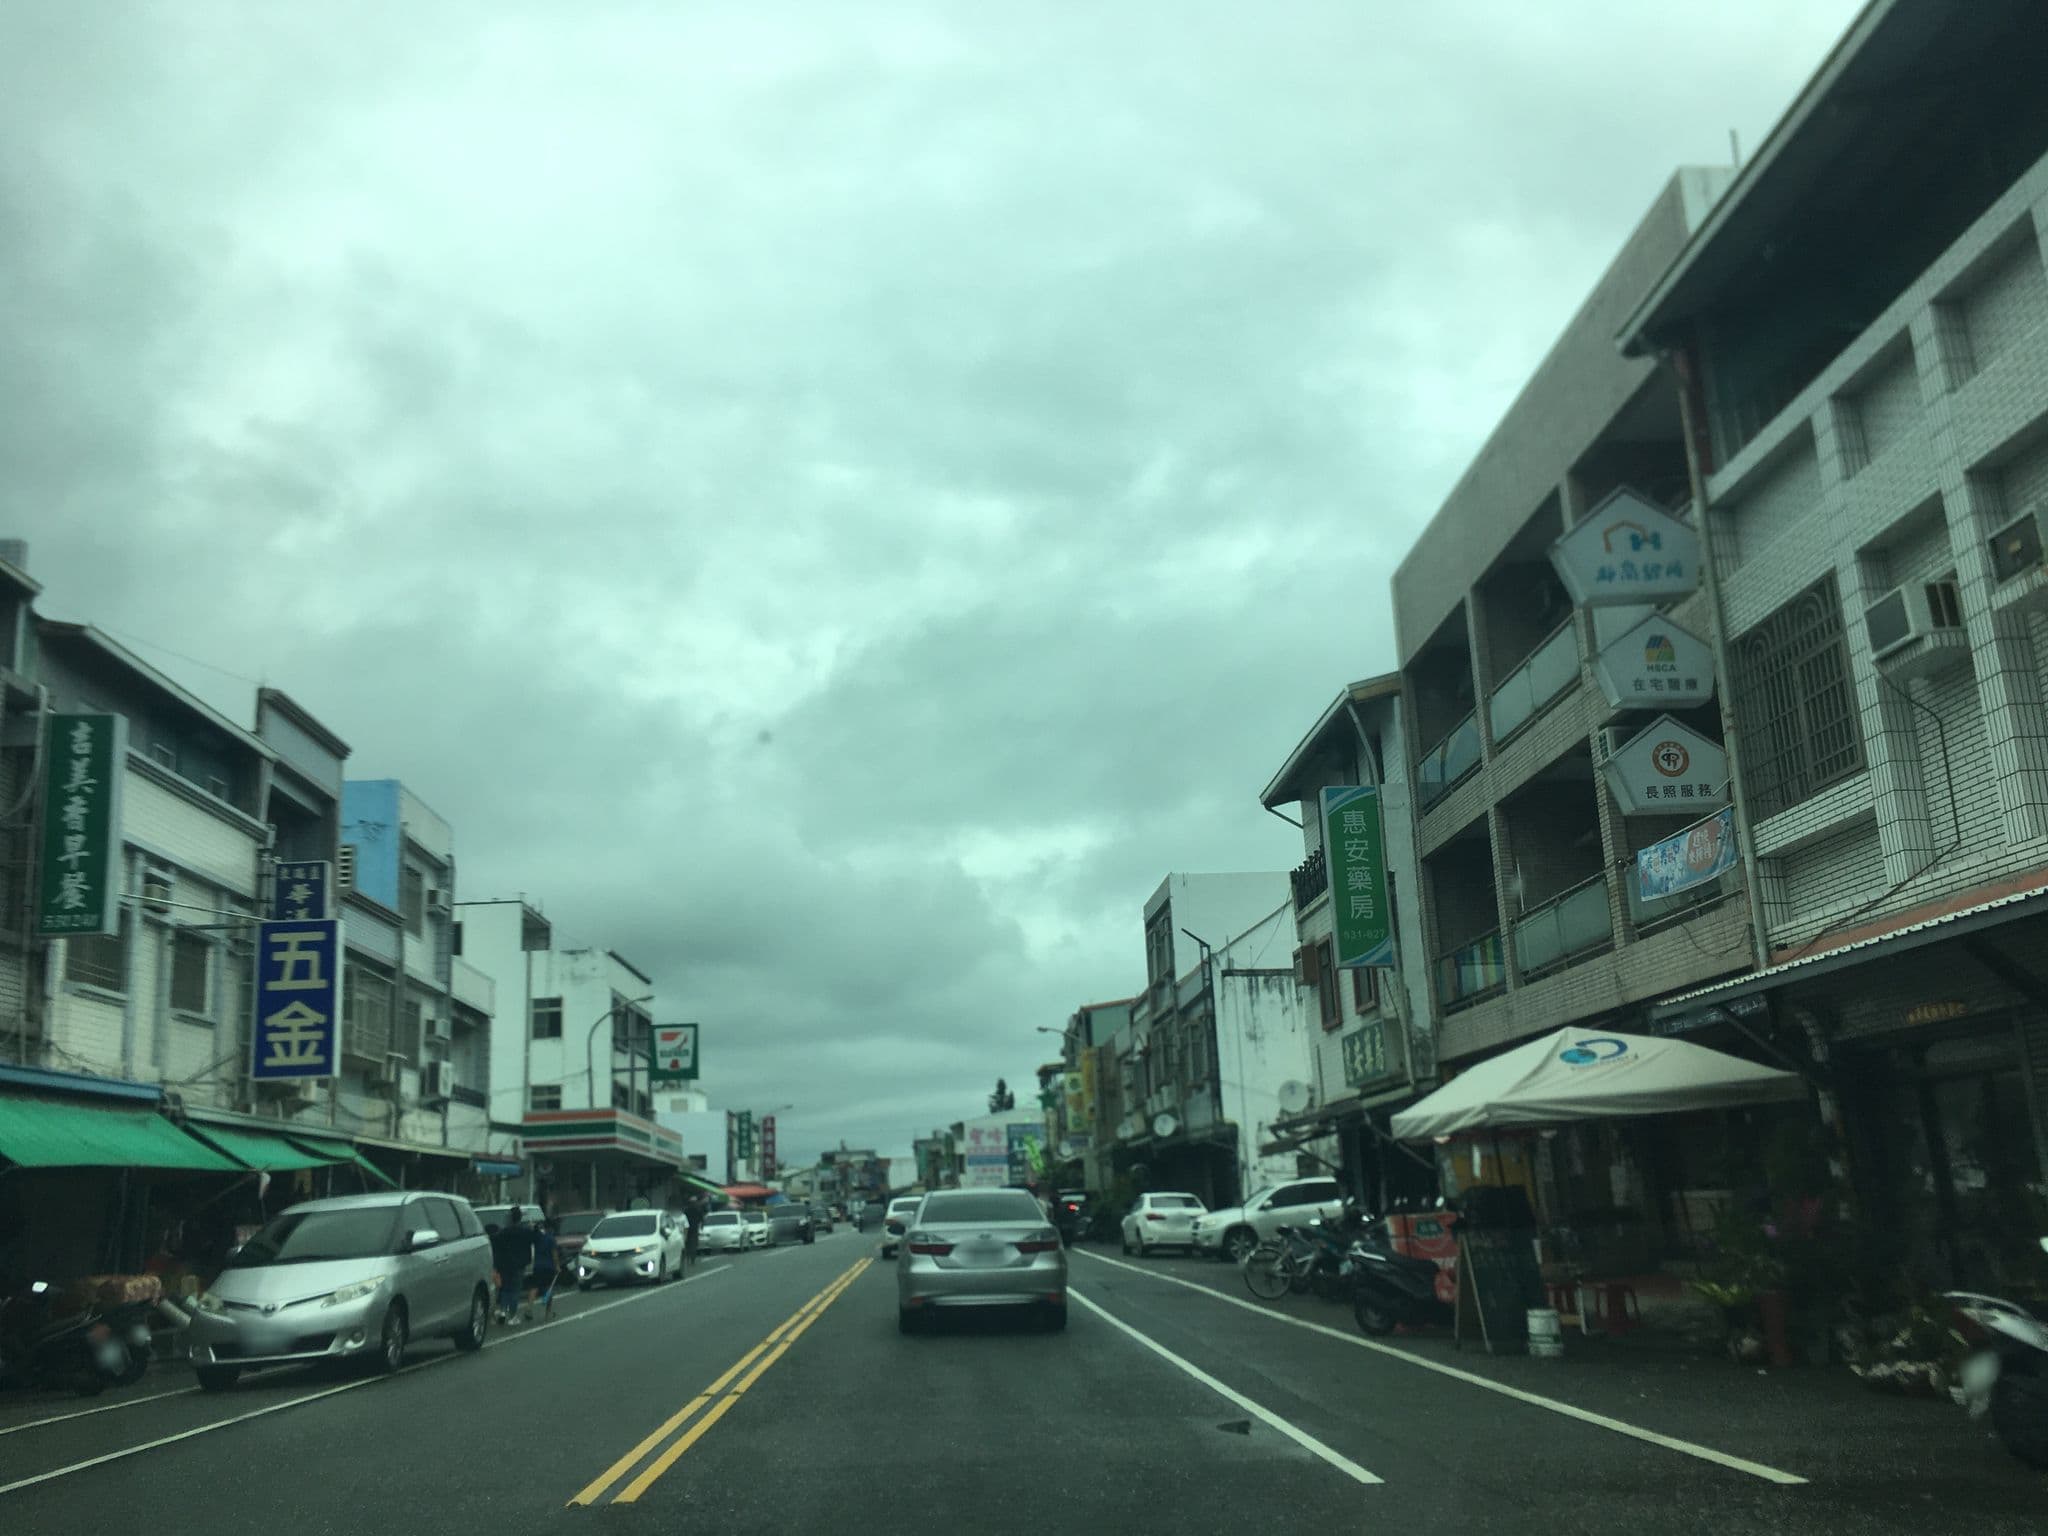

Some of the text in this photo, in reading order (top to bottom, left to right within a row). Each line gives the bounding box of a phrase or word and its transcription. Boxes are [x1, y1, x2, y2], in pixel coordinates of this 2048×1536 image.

[1632, 677, 1698, 691] 在宅醫療
[1645, 783, 1712, 799] 長照服務
[1342, 809, 1375, 920] 惠安藥房
[263, 931, 329, 1067] 五金
